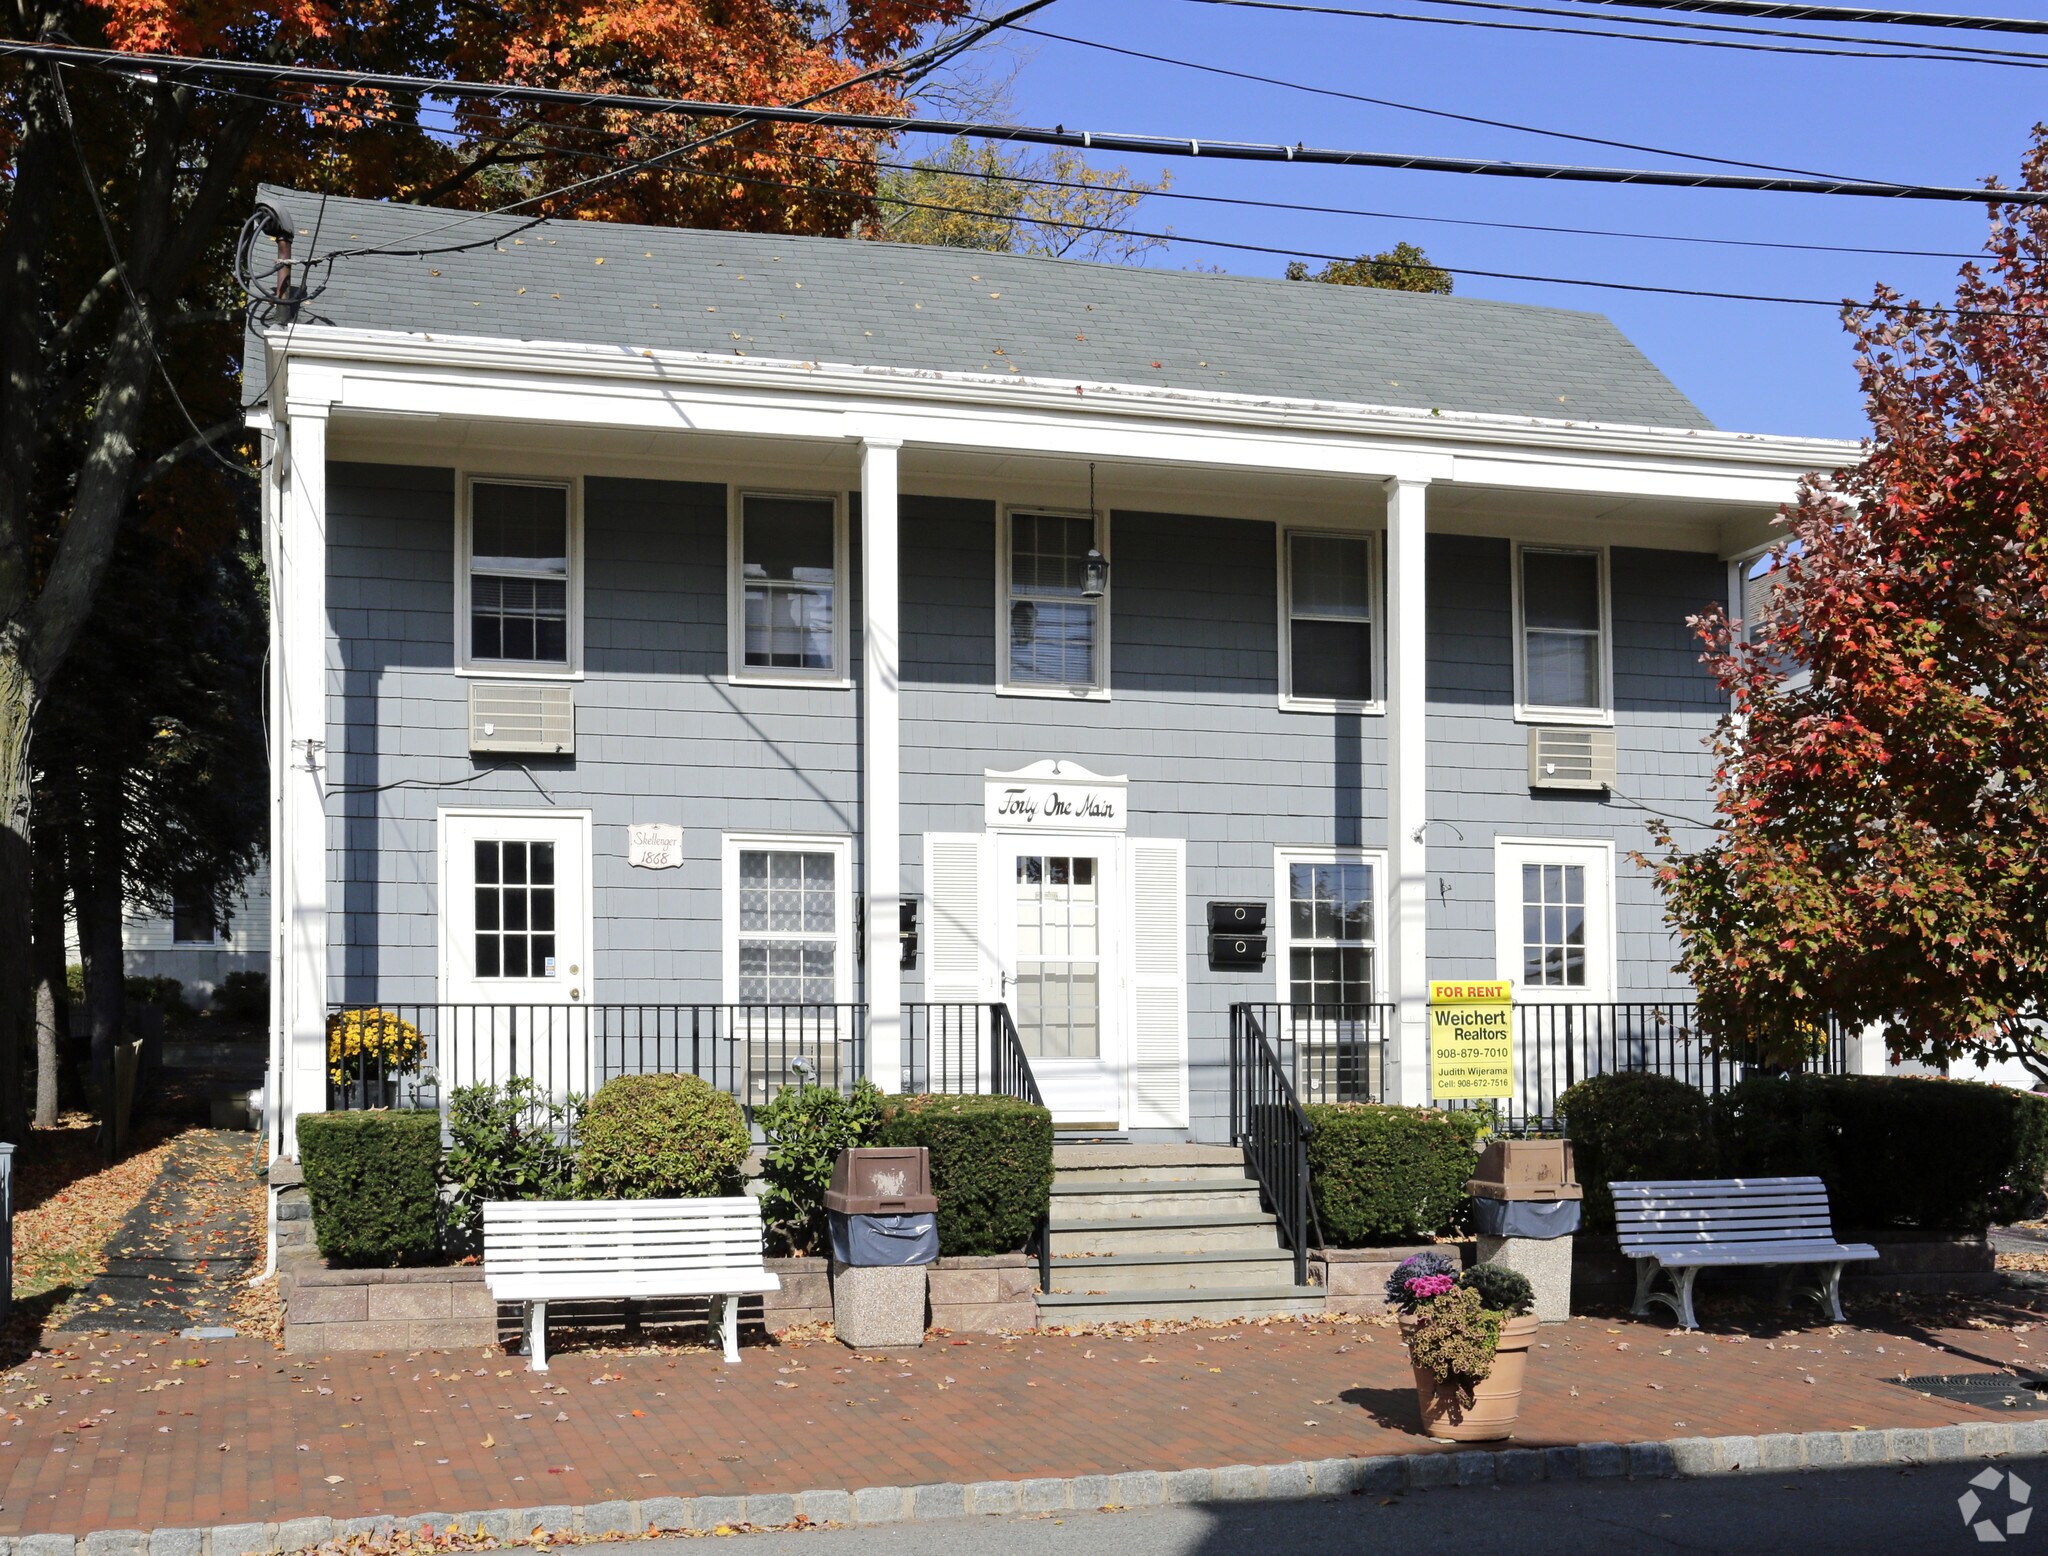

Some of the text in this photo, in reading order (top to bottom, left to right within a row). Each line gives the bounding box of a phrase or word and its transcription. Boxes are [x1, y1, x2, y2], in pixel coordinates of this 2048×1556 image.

[998, 788, 1115, 822] Forty One Main
[633, 831, 677, 851] Skellenger
[641, 851, 669, 865] 1868
[1436, 986, 1503, 998] FOR RENT
[1437, 1048, 1508, 1059] 908-879-7010
[1438, 1067, 1508, 1077] Judith Wijerama
[1438, 1079, 1508, 1088] Cell: 908-672-7516
